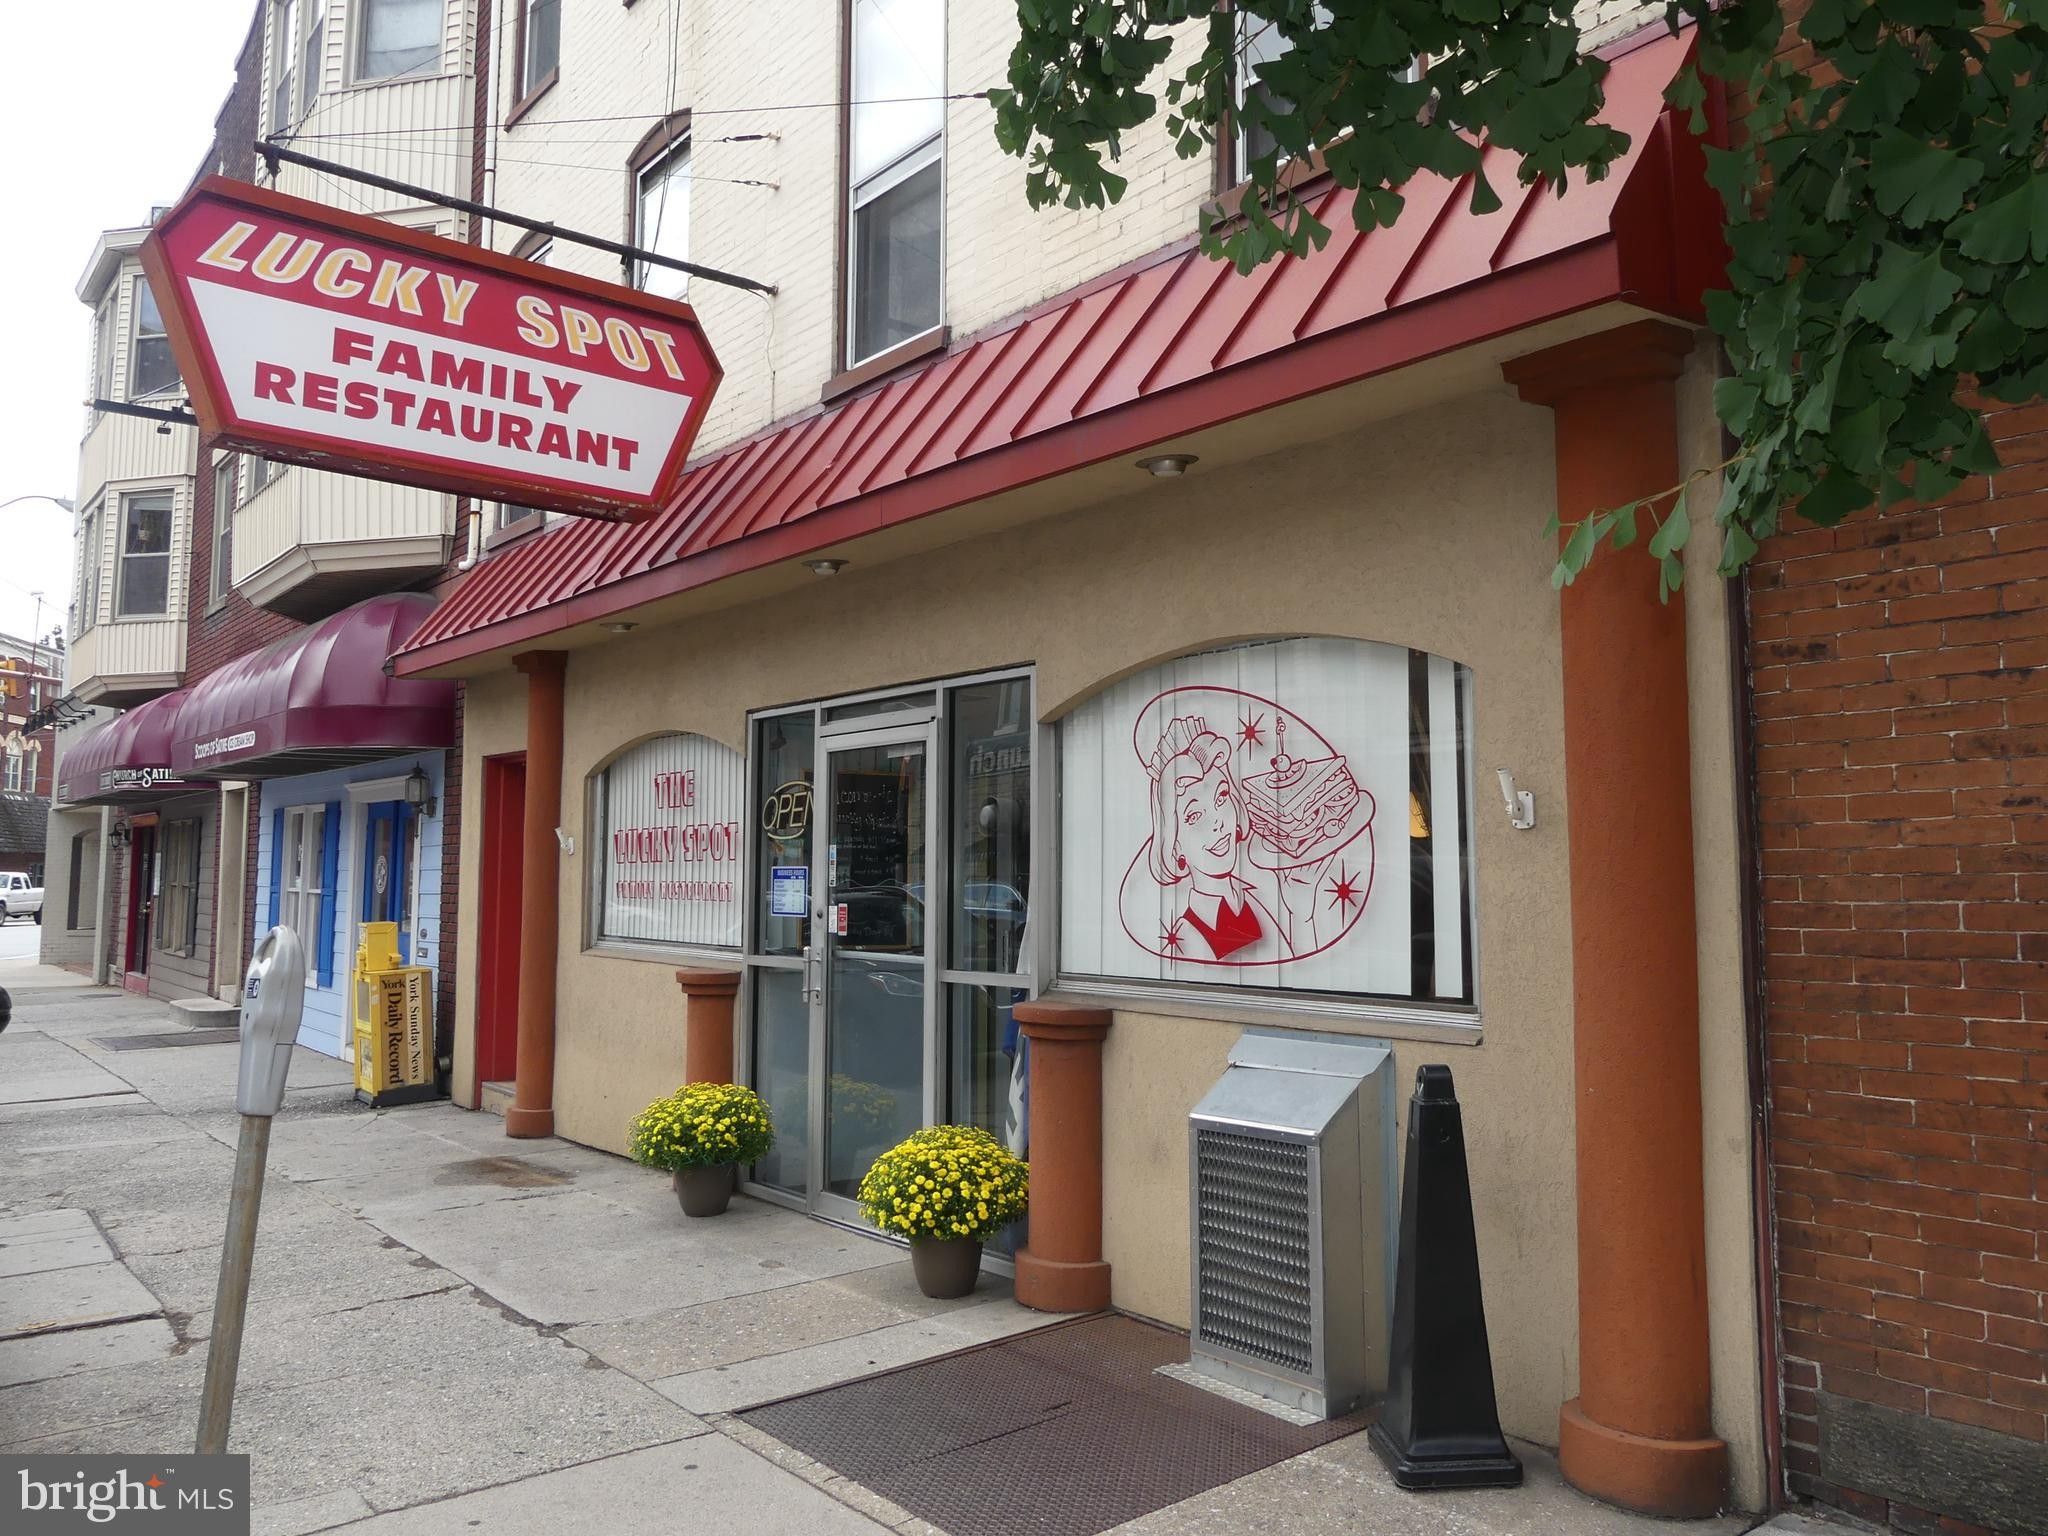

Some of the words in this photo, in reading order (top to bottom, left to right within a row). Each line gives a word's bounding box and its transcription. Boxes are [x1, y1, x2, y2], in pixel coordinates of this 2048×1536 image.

[196, 221, 479, 326] LUCKY
[516, 295, 685, 381] SPOT
[332, 327, 583, 414] FAMILY
[253, 361, 639, 472] RESTAURANT
[142, 768, 177, 788] SATI
[654, 770, 695, 809] THE
[762, 791, 814, 830] OPEN
[614, 826, 678, 864] LUCKY
[683, 822, 739, 862] SPOT
[382, 979, 406, 990] York
[409, 975, 419, 1003] York
[385, 992, 403, 1030] Daily
[409, 1006, 421, 1047] Sunday
[388, 1032, 404, 1085] Record
[411, 1049, 421, 1080] News
